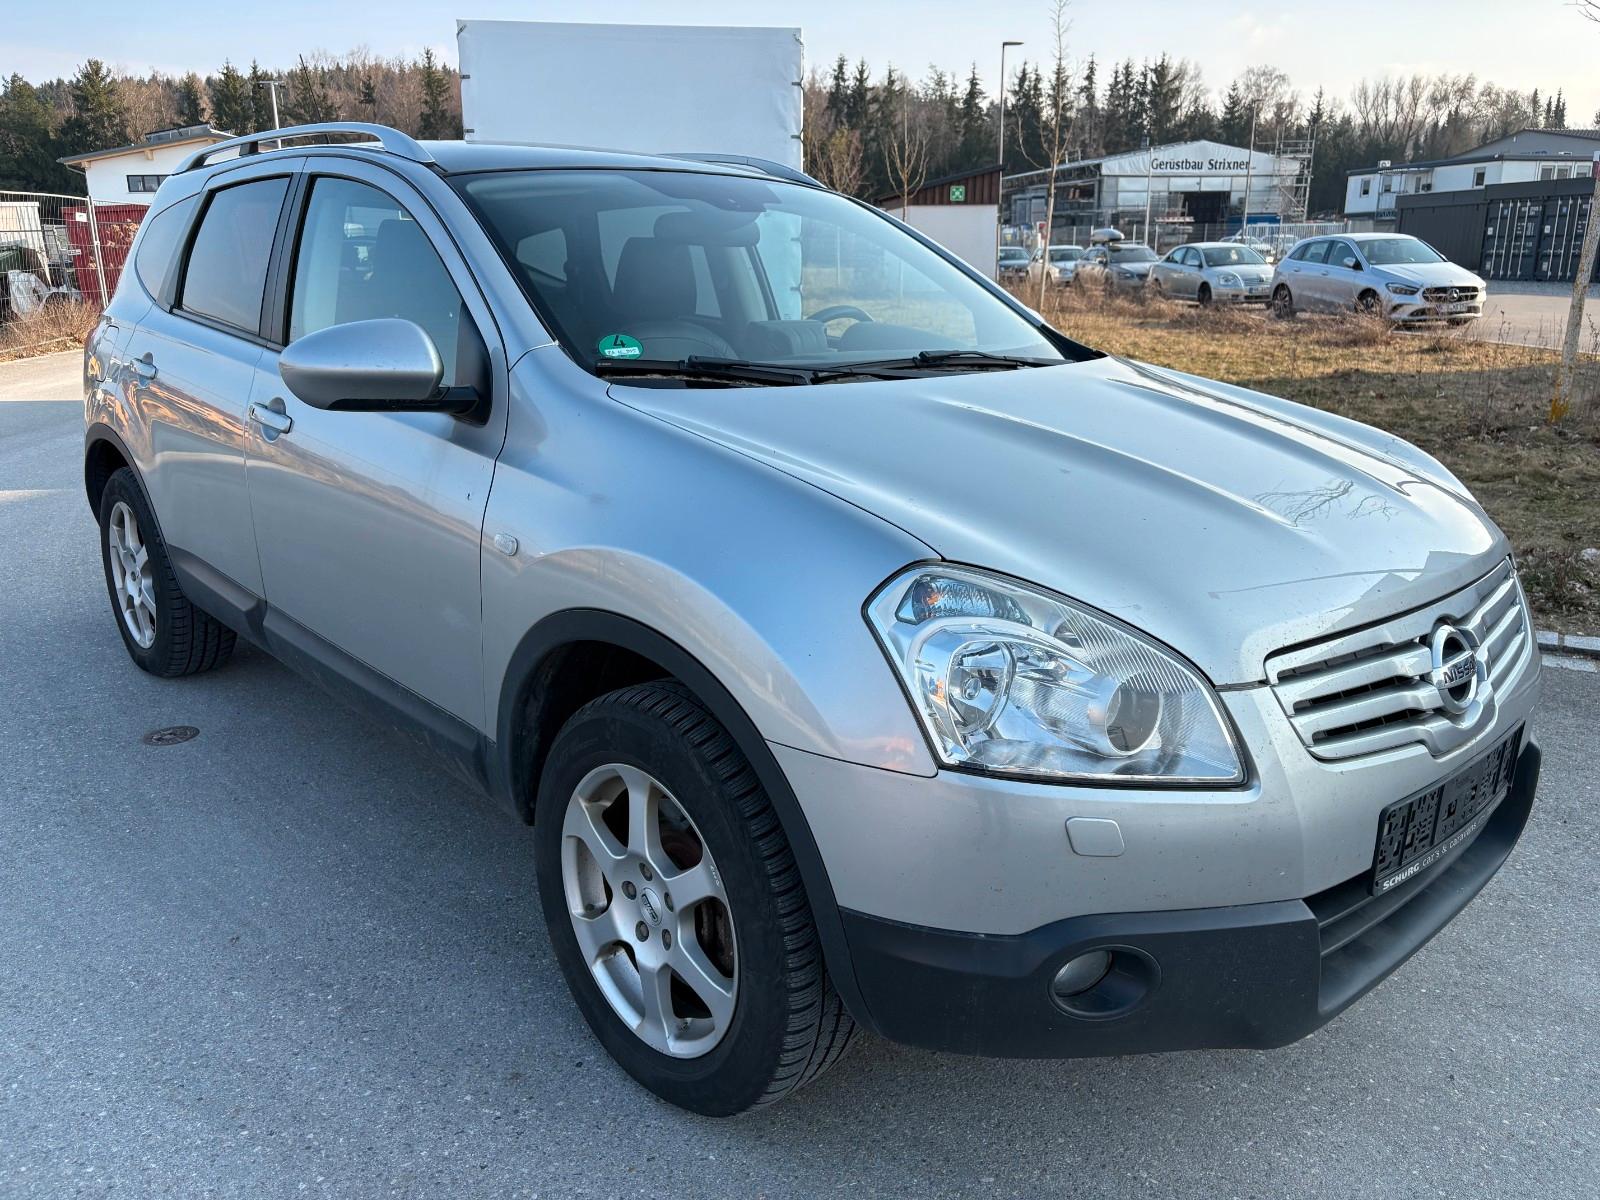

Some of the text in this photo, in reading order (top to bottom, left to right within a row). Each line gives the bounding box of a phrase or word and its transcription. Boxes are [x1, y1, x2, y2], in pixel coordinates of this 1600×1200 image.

[1151, 158, 1249, 170] Gerüstbau Strixner
[613, 334, 626, 347] 4
